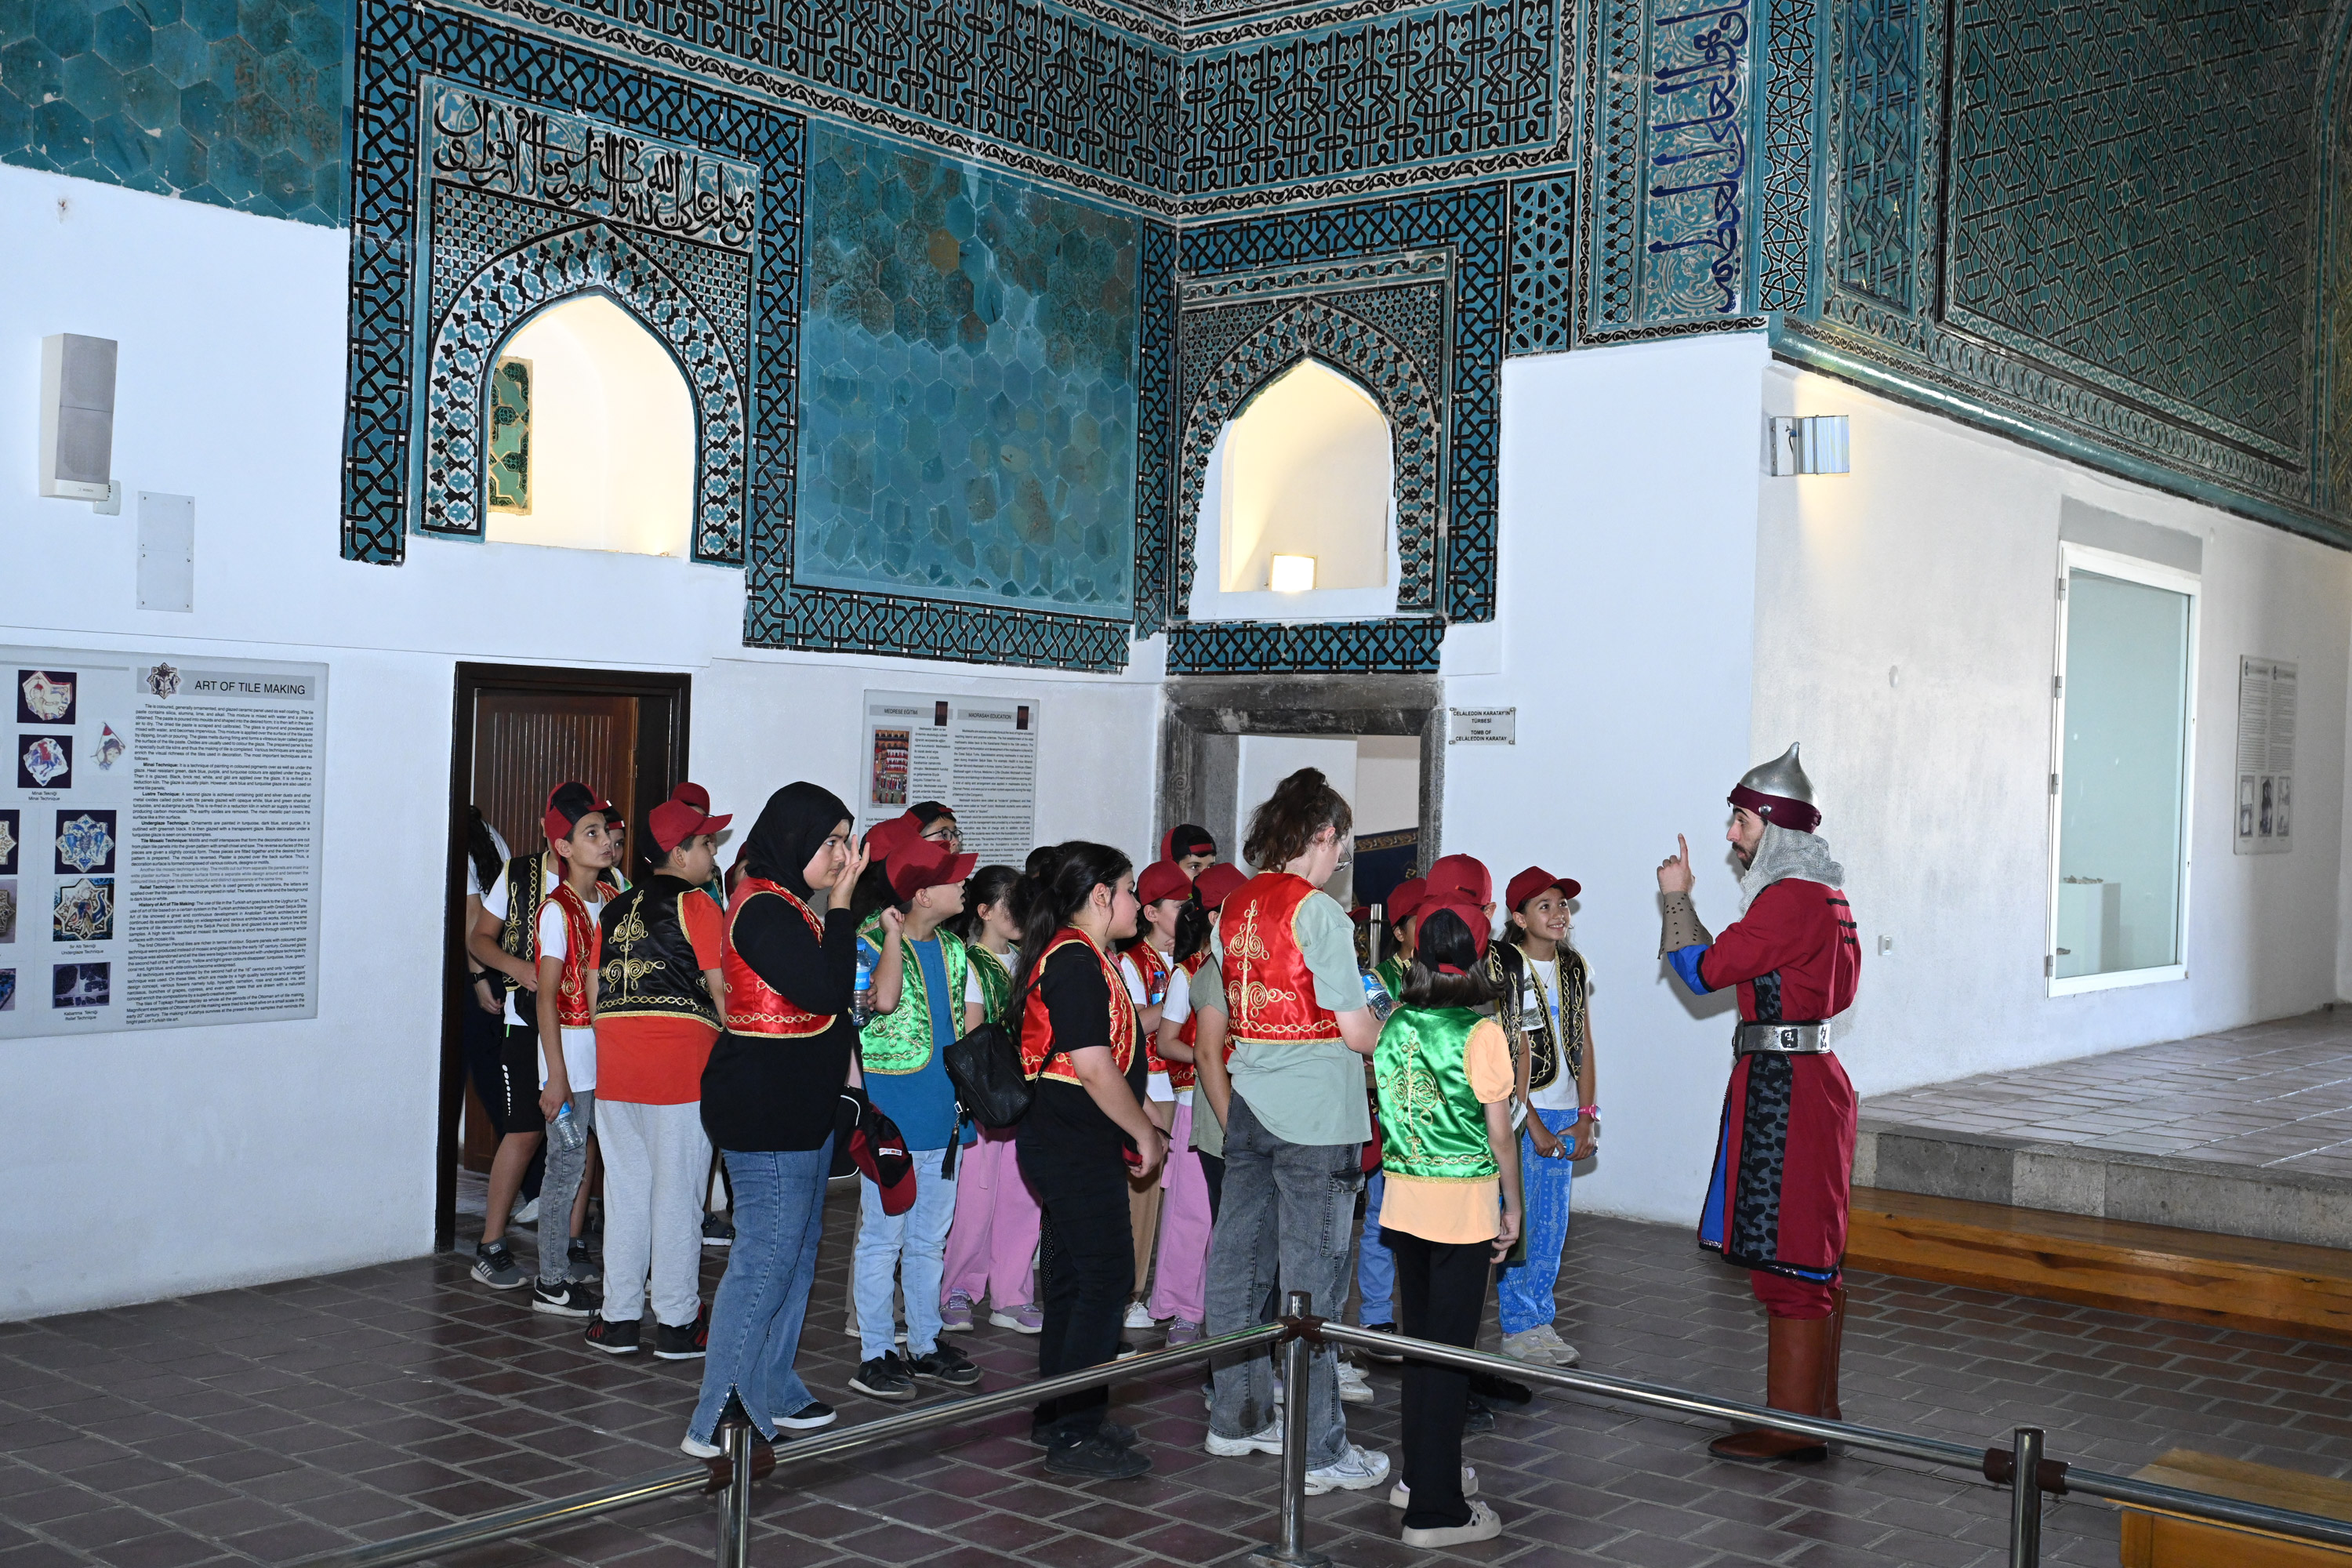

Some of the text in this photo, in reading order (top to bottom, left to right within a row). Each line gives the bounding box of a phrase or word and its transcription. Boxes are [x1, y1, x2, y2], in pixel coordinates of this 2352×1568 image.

[194, 680, 306, 695] ART OF TILE MAKING
